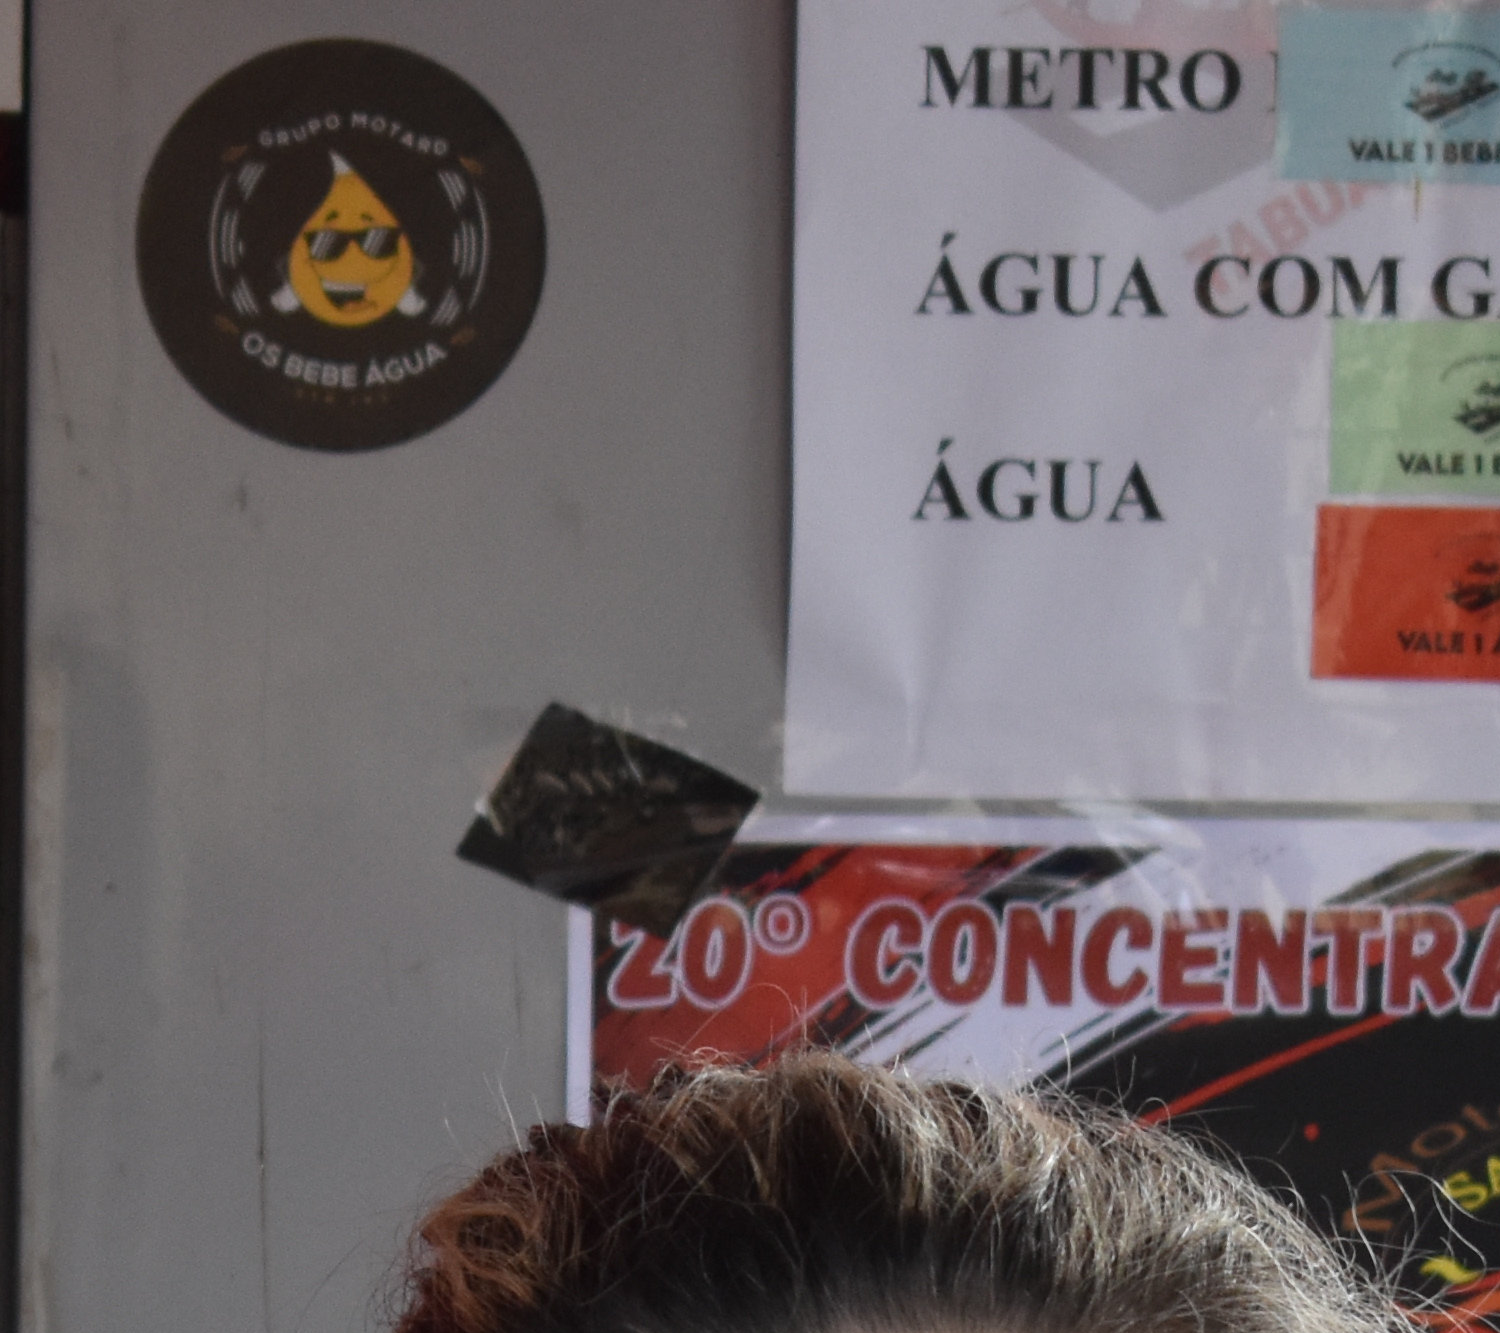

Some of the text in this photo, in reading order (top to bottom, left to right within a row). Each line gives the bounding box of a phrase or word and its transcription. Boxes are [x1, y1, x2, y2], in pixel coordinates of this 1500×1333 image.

[918, 45, 1242, 113] METRO
[259, 112, 448, 155] GRUPO MOTARD
[1350, 139, 1415, 163] VALE
[1425, 142, 1434, 163] 1
[915, 232, 1167, 317] ÁGUA
[1194, 255, 1404, 319] COM
[242, 332, 281, 368] OS
[284, 354, 357, 388] BEBE
[911, 438, 1166, 523] ÁGUA
[1397, 453, 1464, 475] VALE
[1474, 454, 1482, 475] 1
[1397, 631, 1464, 655] VALE
[1474, 633, 1483, 655] 1
